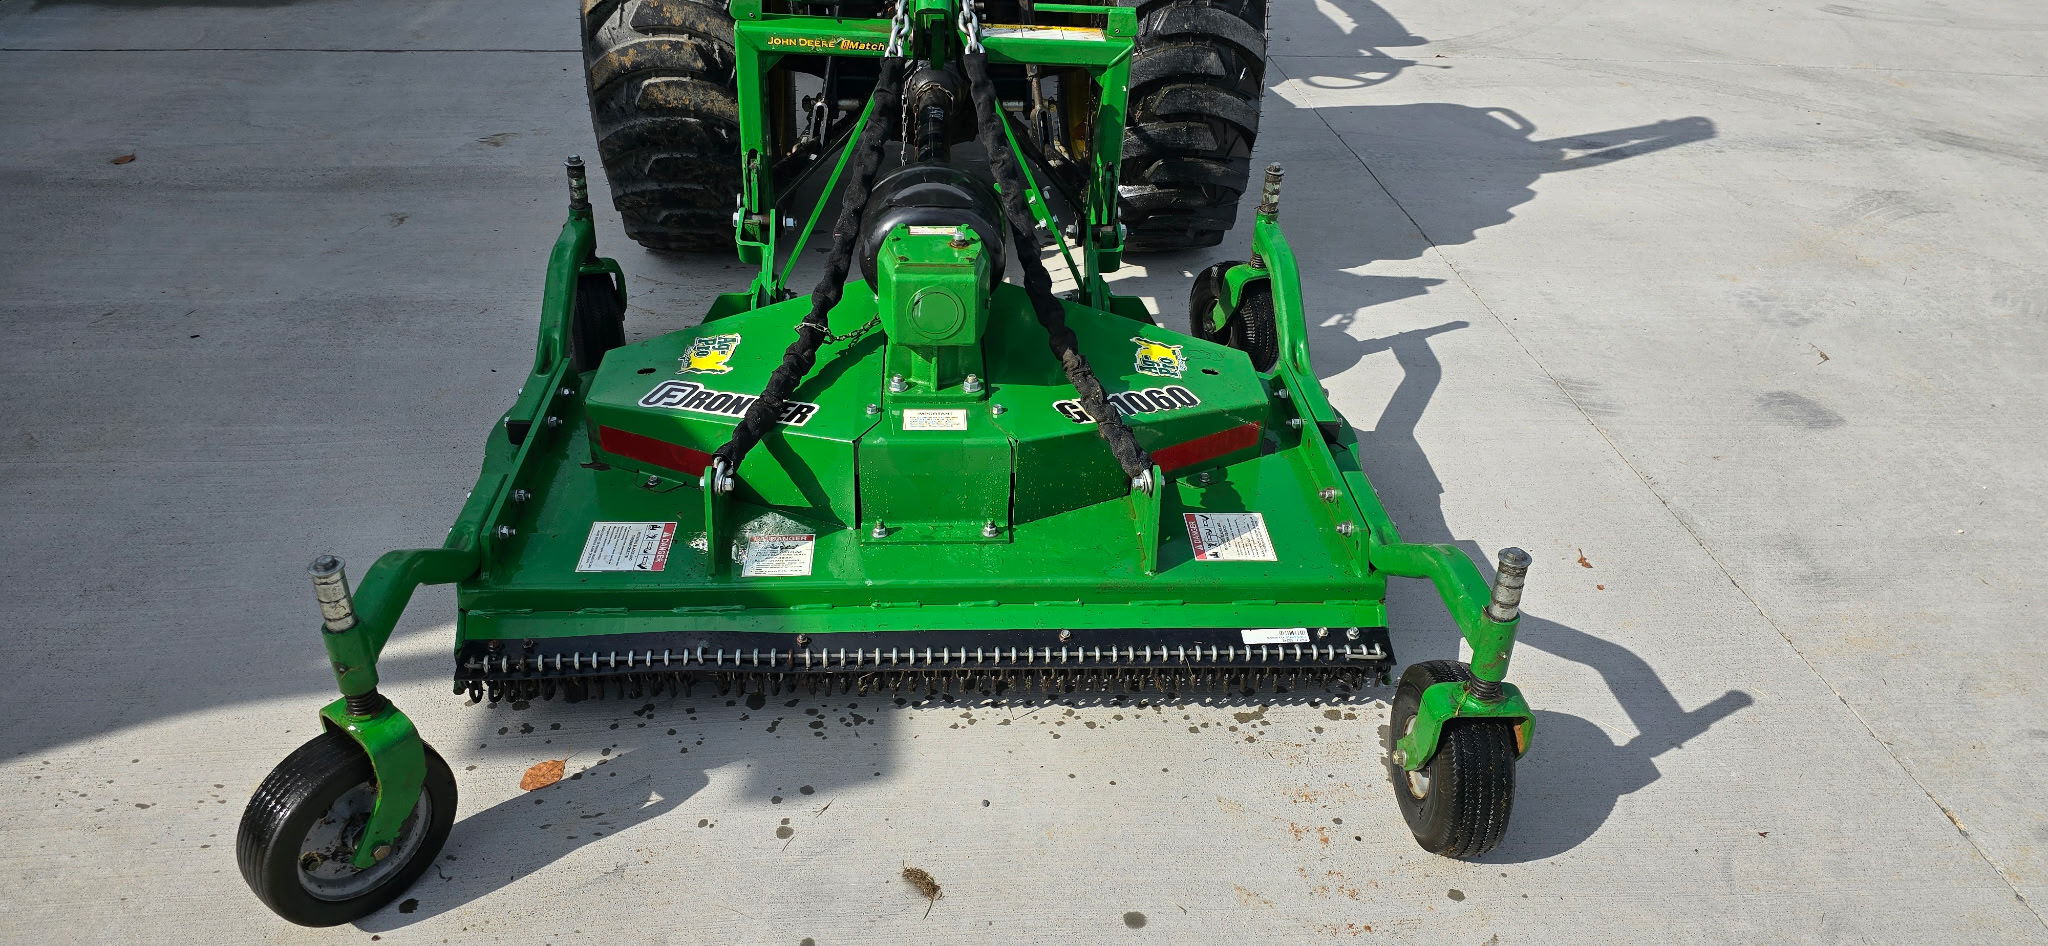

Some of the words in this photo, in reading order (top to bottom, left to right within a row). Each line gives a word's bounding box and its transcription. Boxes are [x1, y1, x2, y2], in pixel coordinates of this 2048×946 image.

[767, 36, 797, 46] JOHN
[799, 38, 835, 48] DEERE
[641, 381, 816, 424] FRONER
[1055, 386, 1199, 423] G1060
